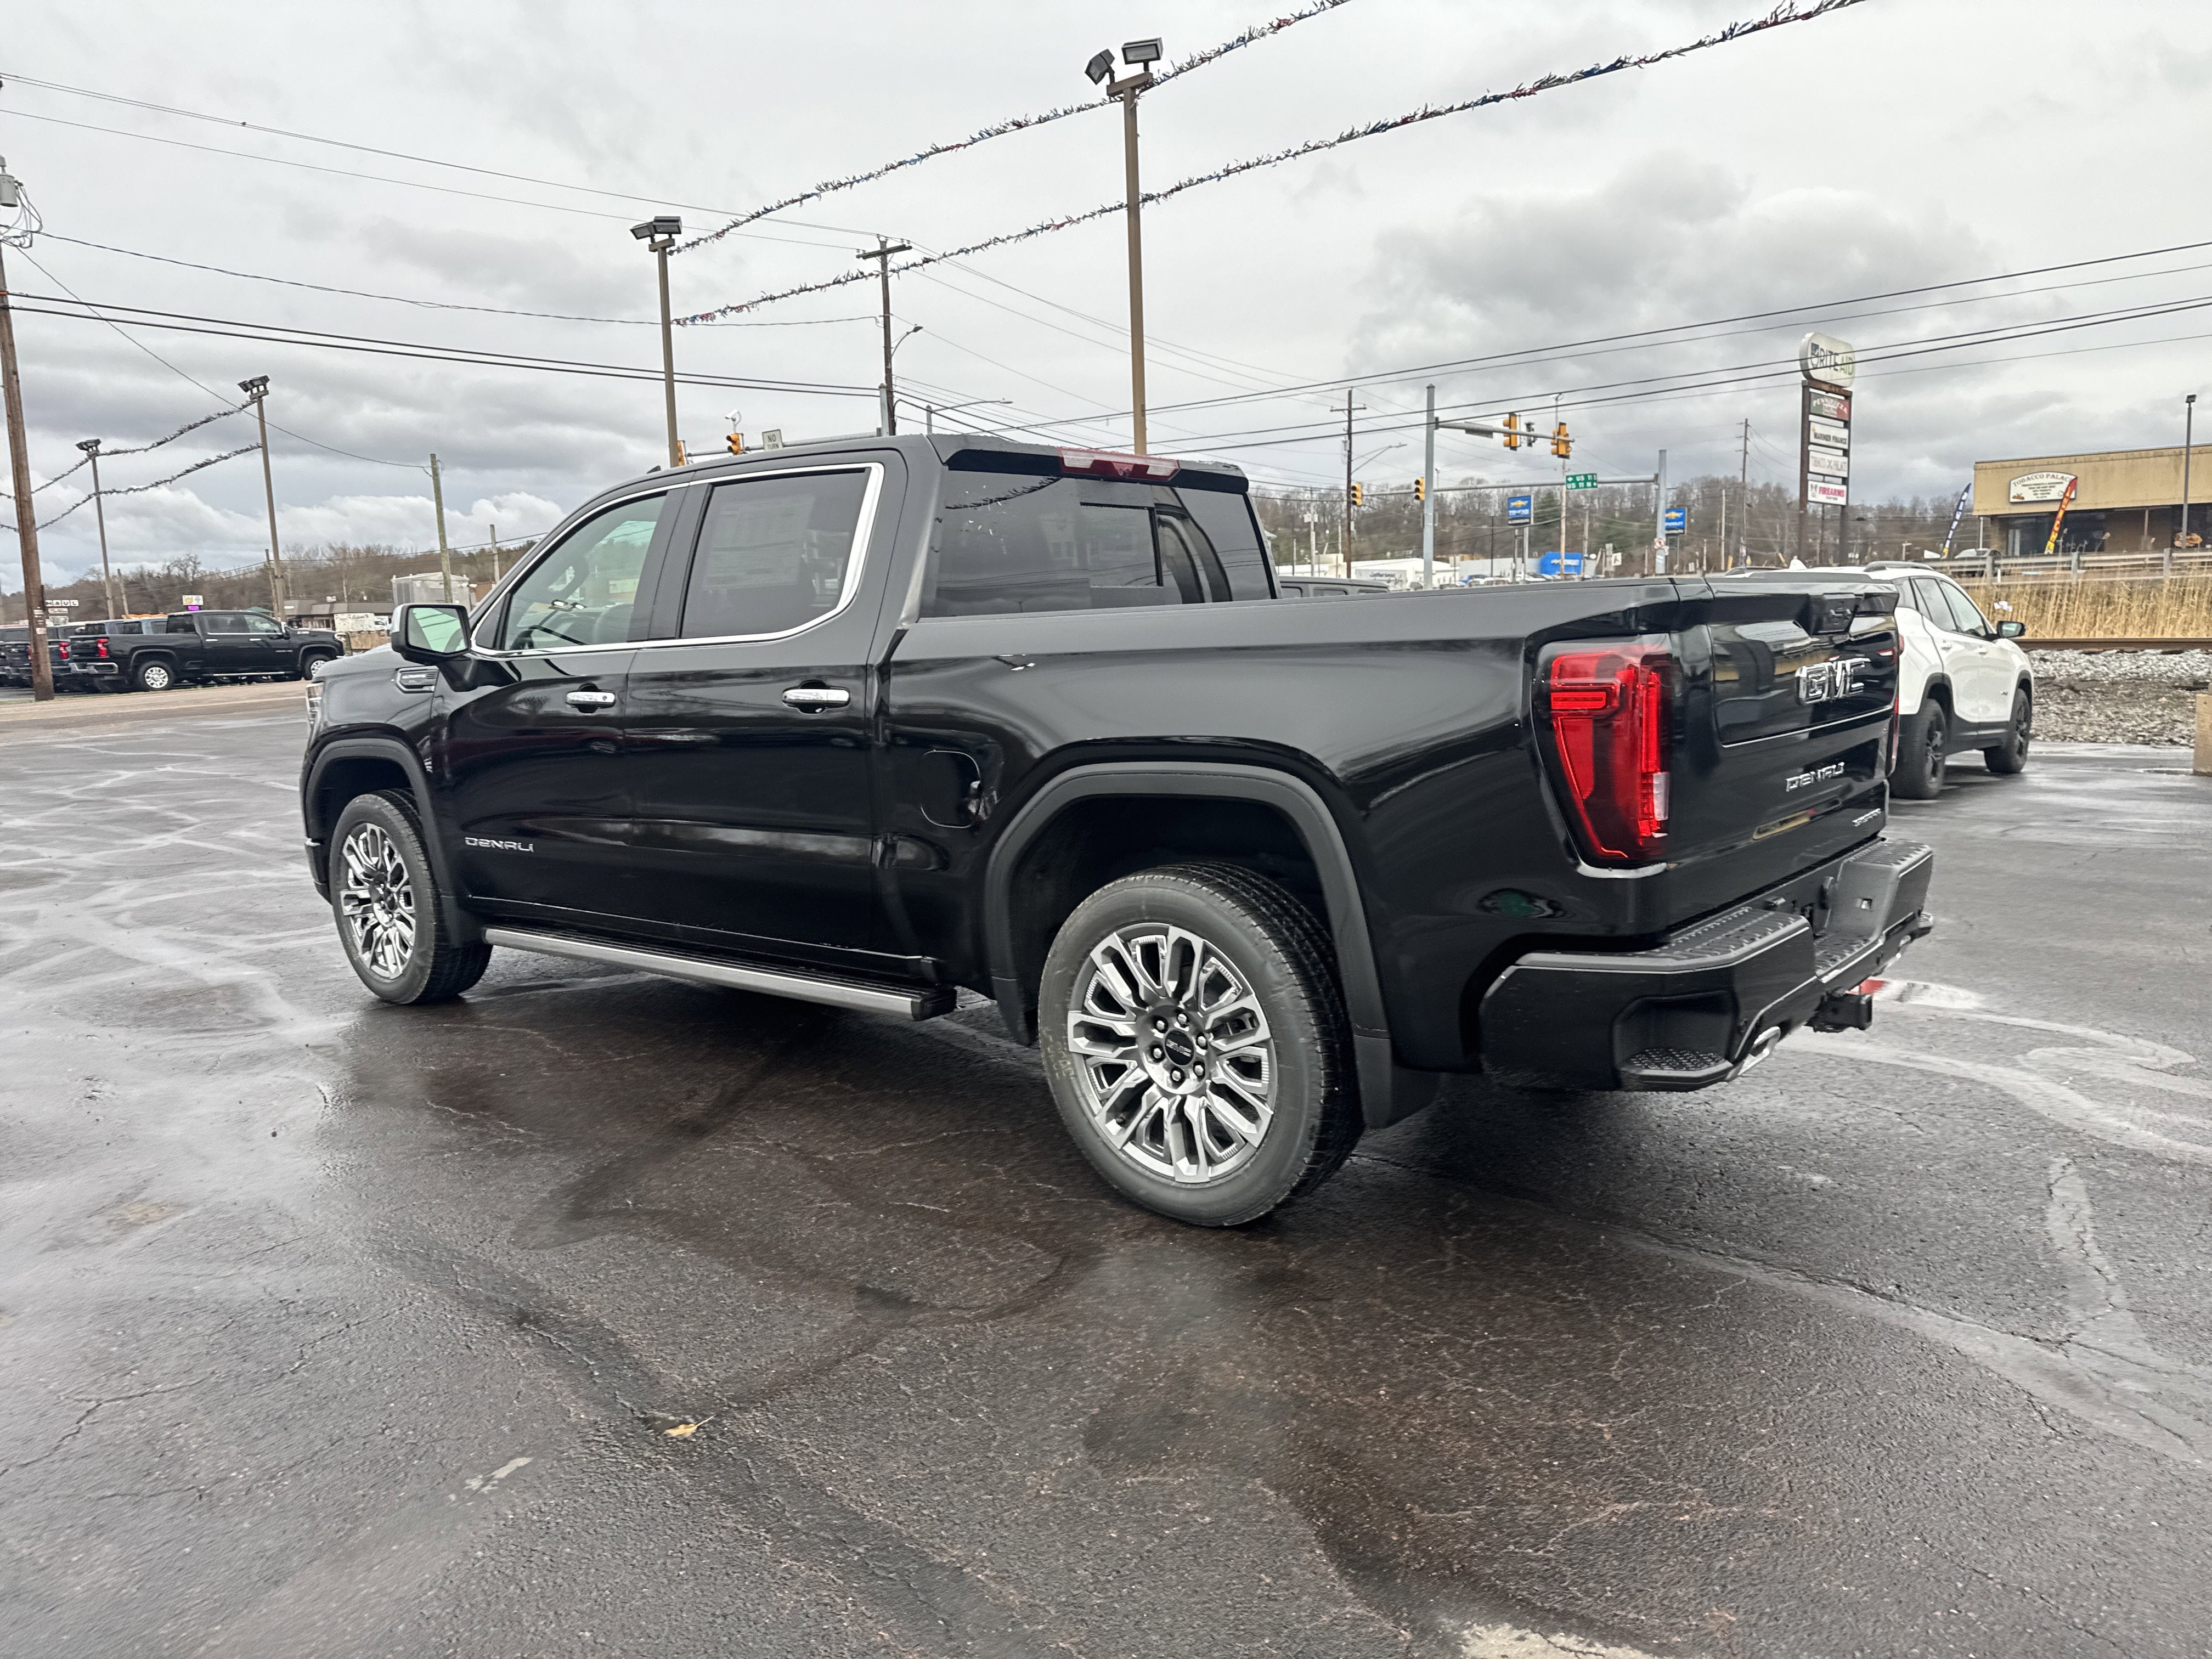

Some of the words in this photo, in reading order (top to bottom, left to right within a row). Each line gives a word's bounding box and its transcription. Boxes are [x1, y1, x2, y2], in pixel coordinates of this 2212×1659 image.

[1820, 347, 1838, 372] RITE
[1839, 356, 1854, 376] AID
[768, 434, 776, 442] NO
[2012, 473, 2045, 487] TOBACCO
[1795, 658, 1871, 704] GMC
[1786, 761, 1845, 792] DENALI
[465, 837, 534, 853] DENALI
[1166, 1039, 1192, 1057] GMC
